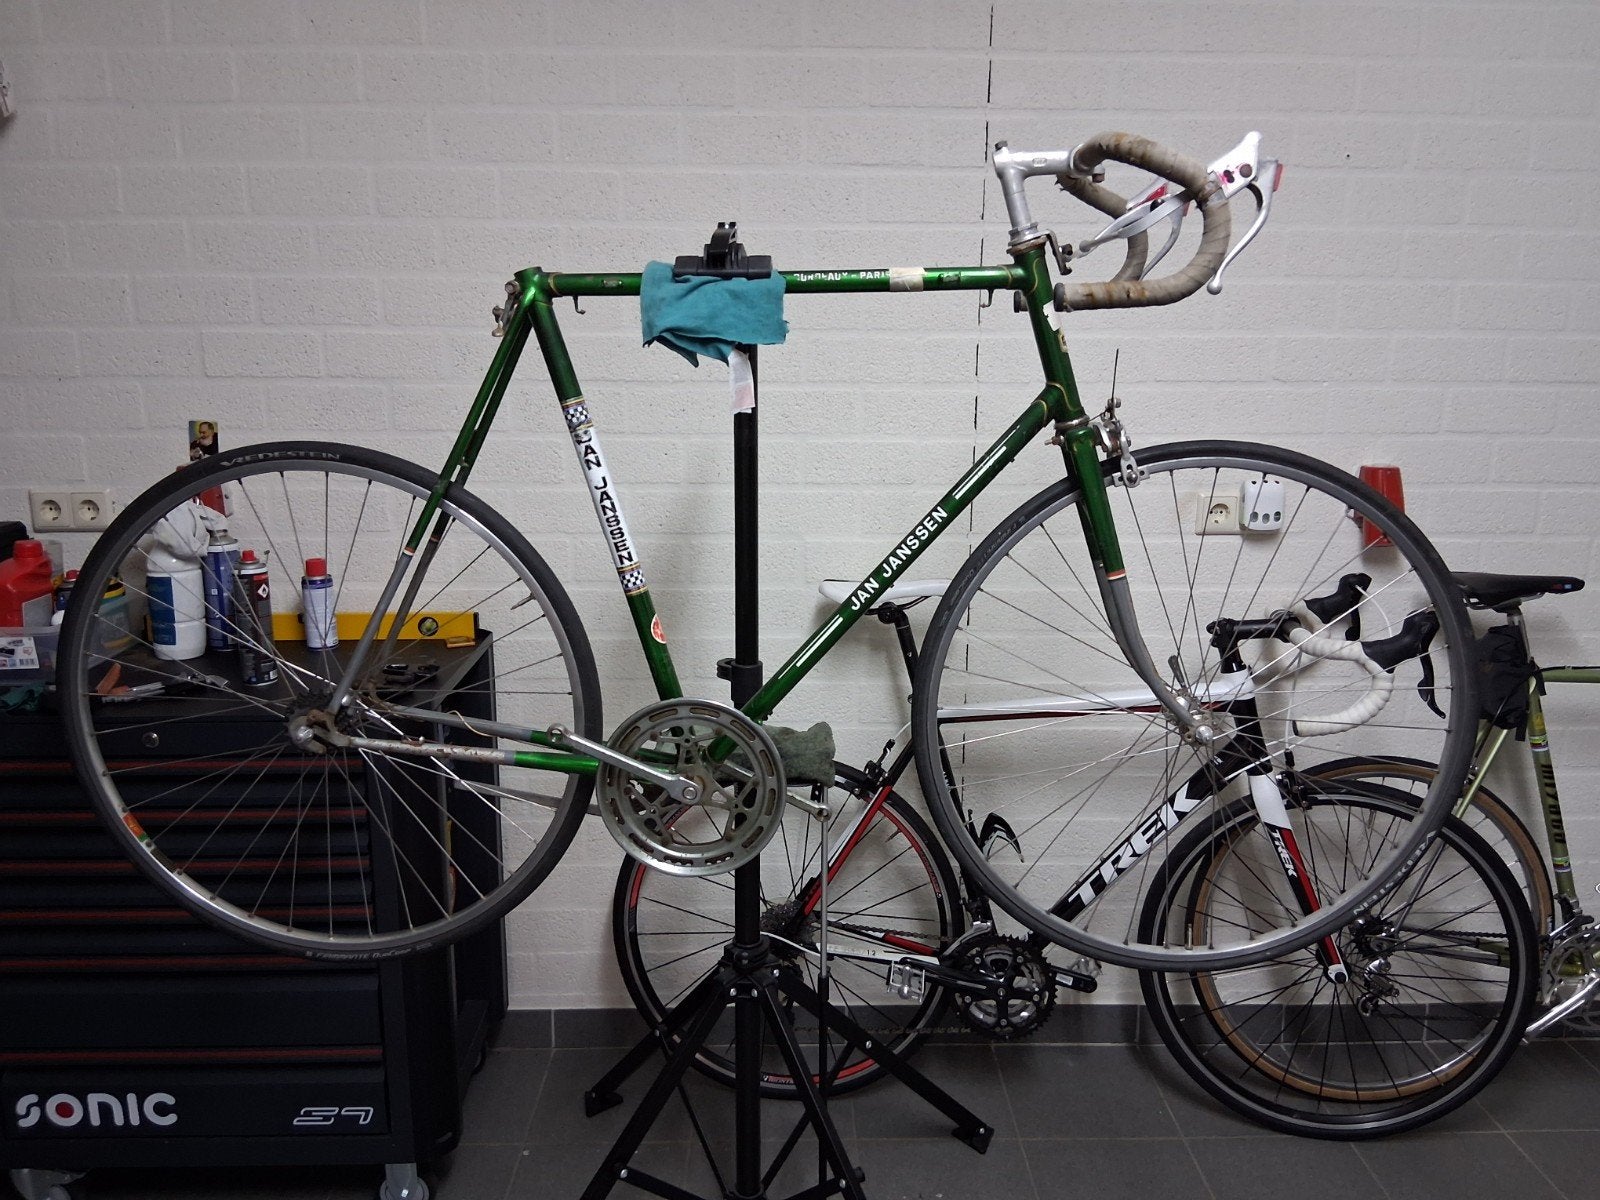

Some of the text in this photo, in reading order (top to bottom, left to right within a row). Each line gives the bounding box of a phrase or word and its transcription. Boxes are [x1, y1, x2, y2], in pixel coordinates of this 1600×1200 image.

[594, 476, 634, 565] JANSSEN
[850, 506, 948, 611] JAN JANSSEN
[1068, 781, 1200, 907] TREK
[1271, 829, 1297, 878] TREK
[1353, 830, 1437, 915] VREDESTEIN
